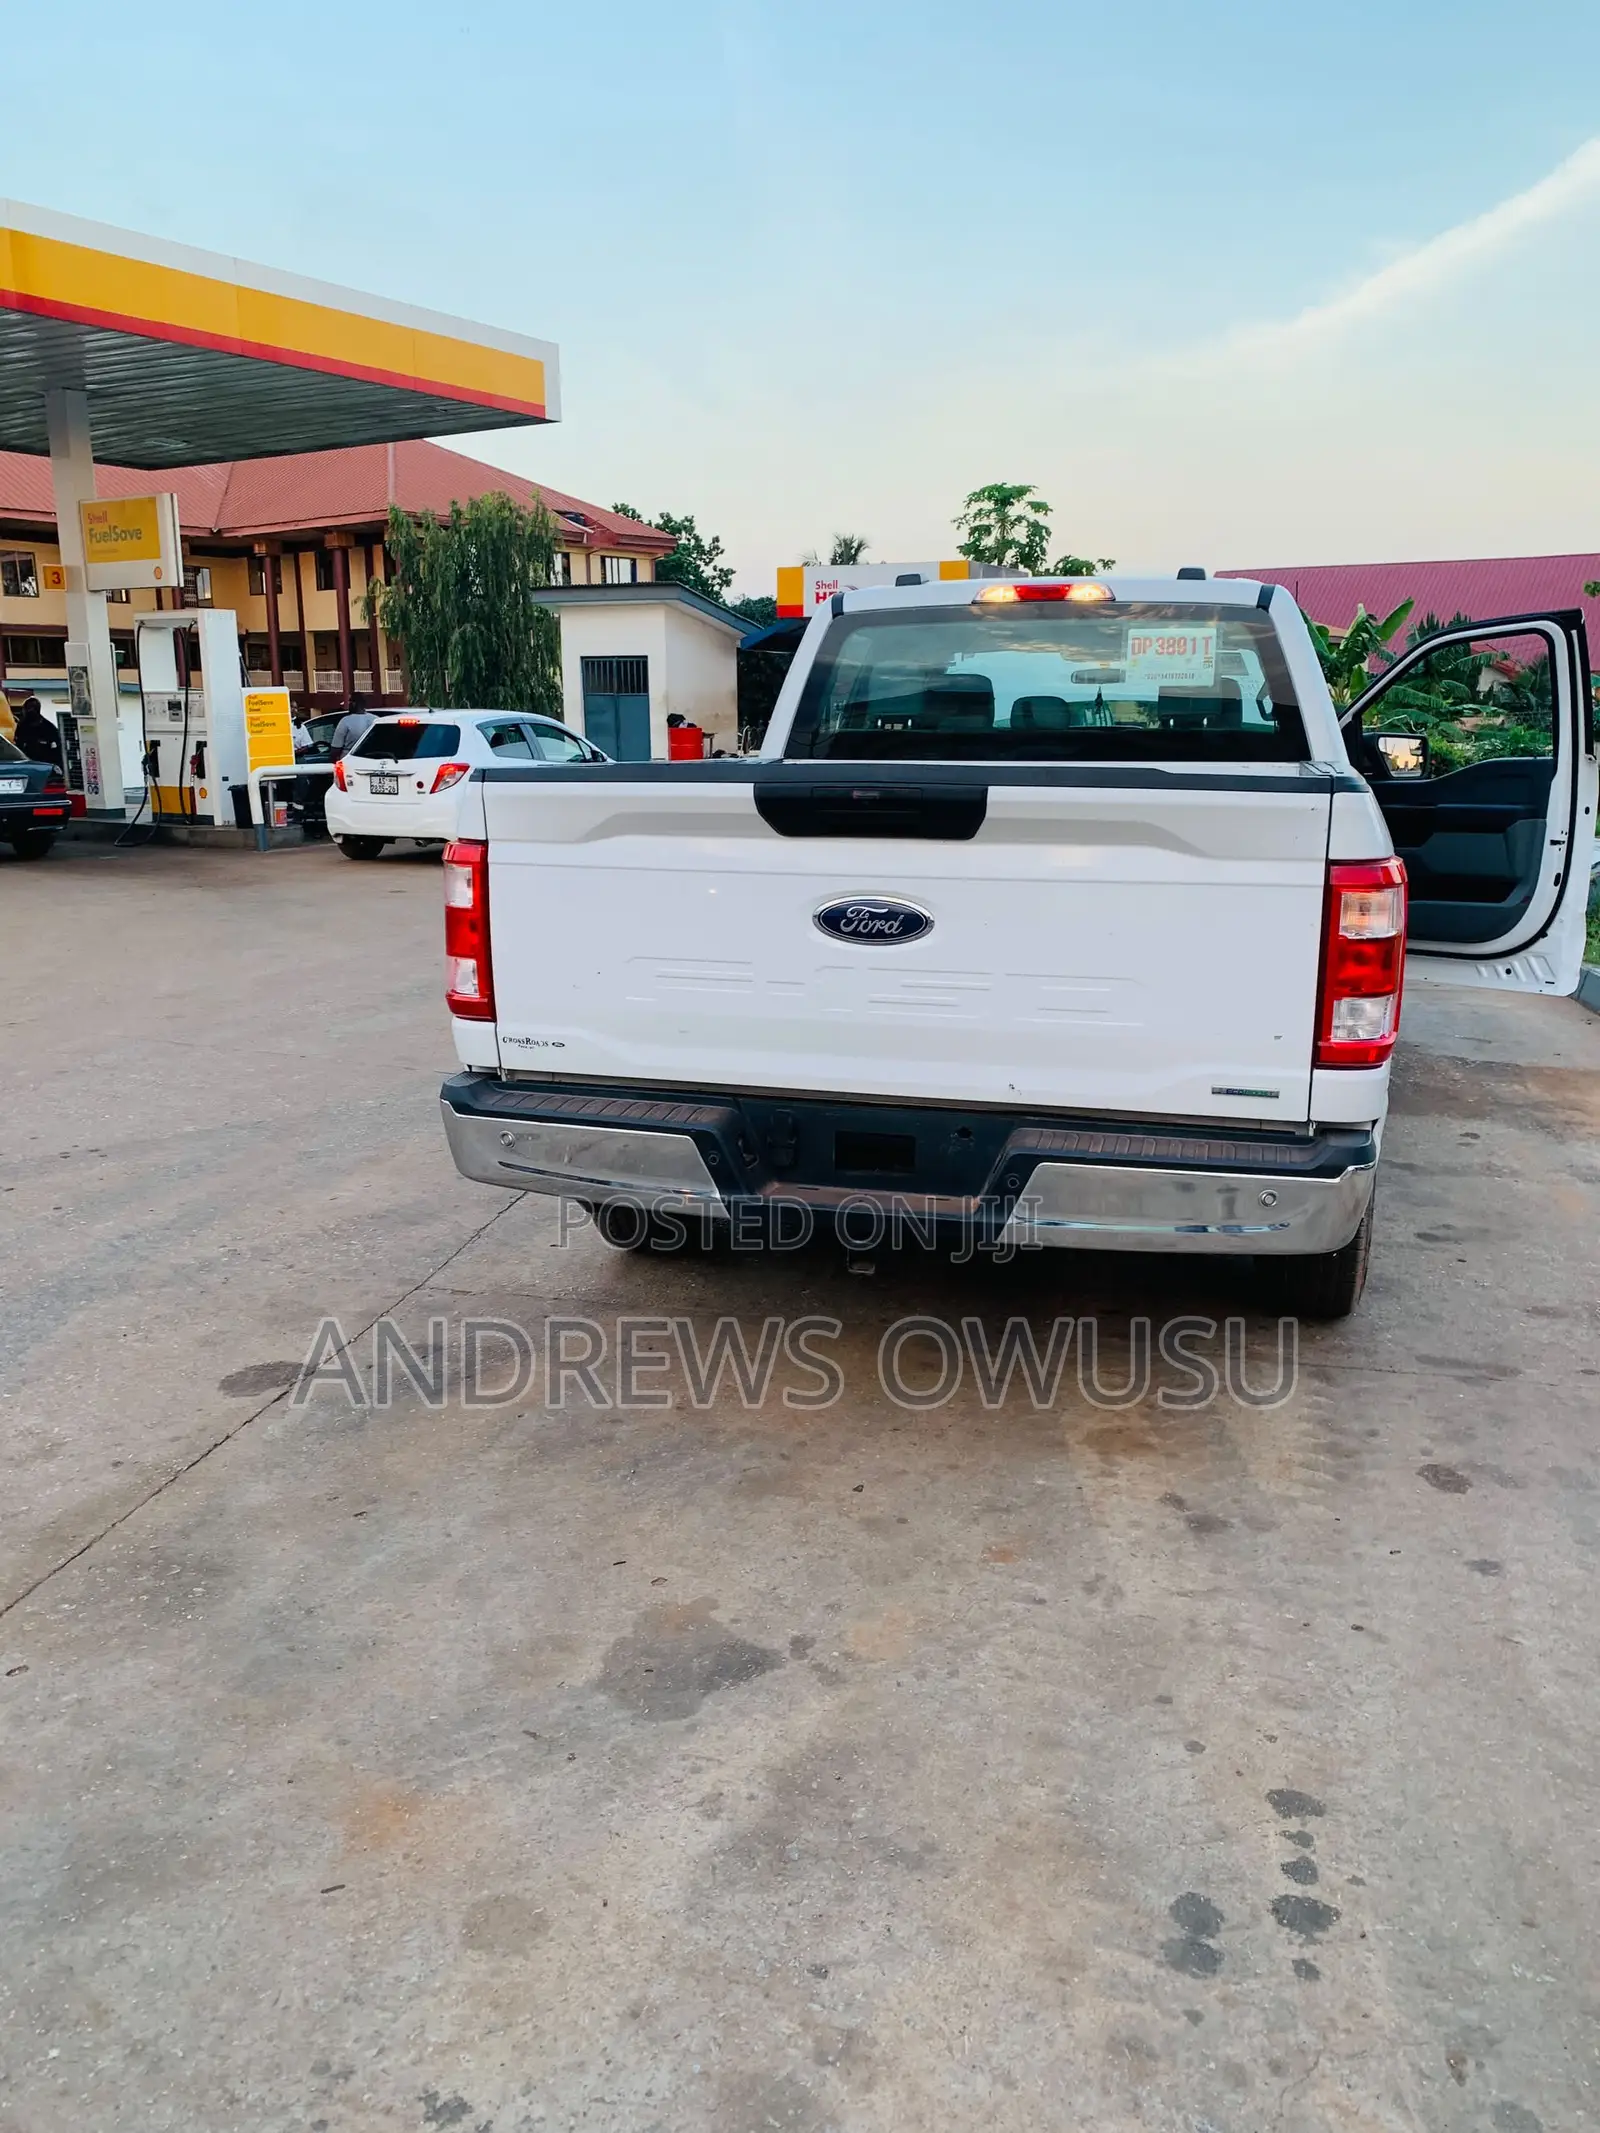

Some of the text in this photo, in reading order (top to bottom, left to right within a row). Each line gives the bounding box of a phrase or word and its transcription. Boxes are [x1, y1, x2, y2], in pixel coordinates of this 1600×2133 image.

[87, 510, 108, 525] Shell
[88, 525, 142, 544] FuelSave
[52, 571, 61, 584] 3
[815, 580, 838, 590] Shell
[840, 906, 904, 935] Ford
